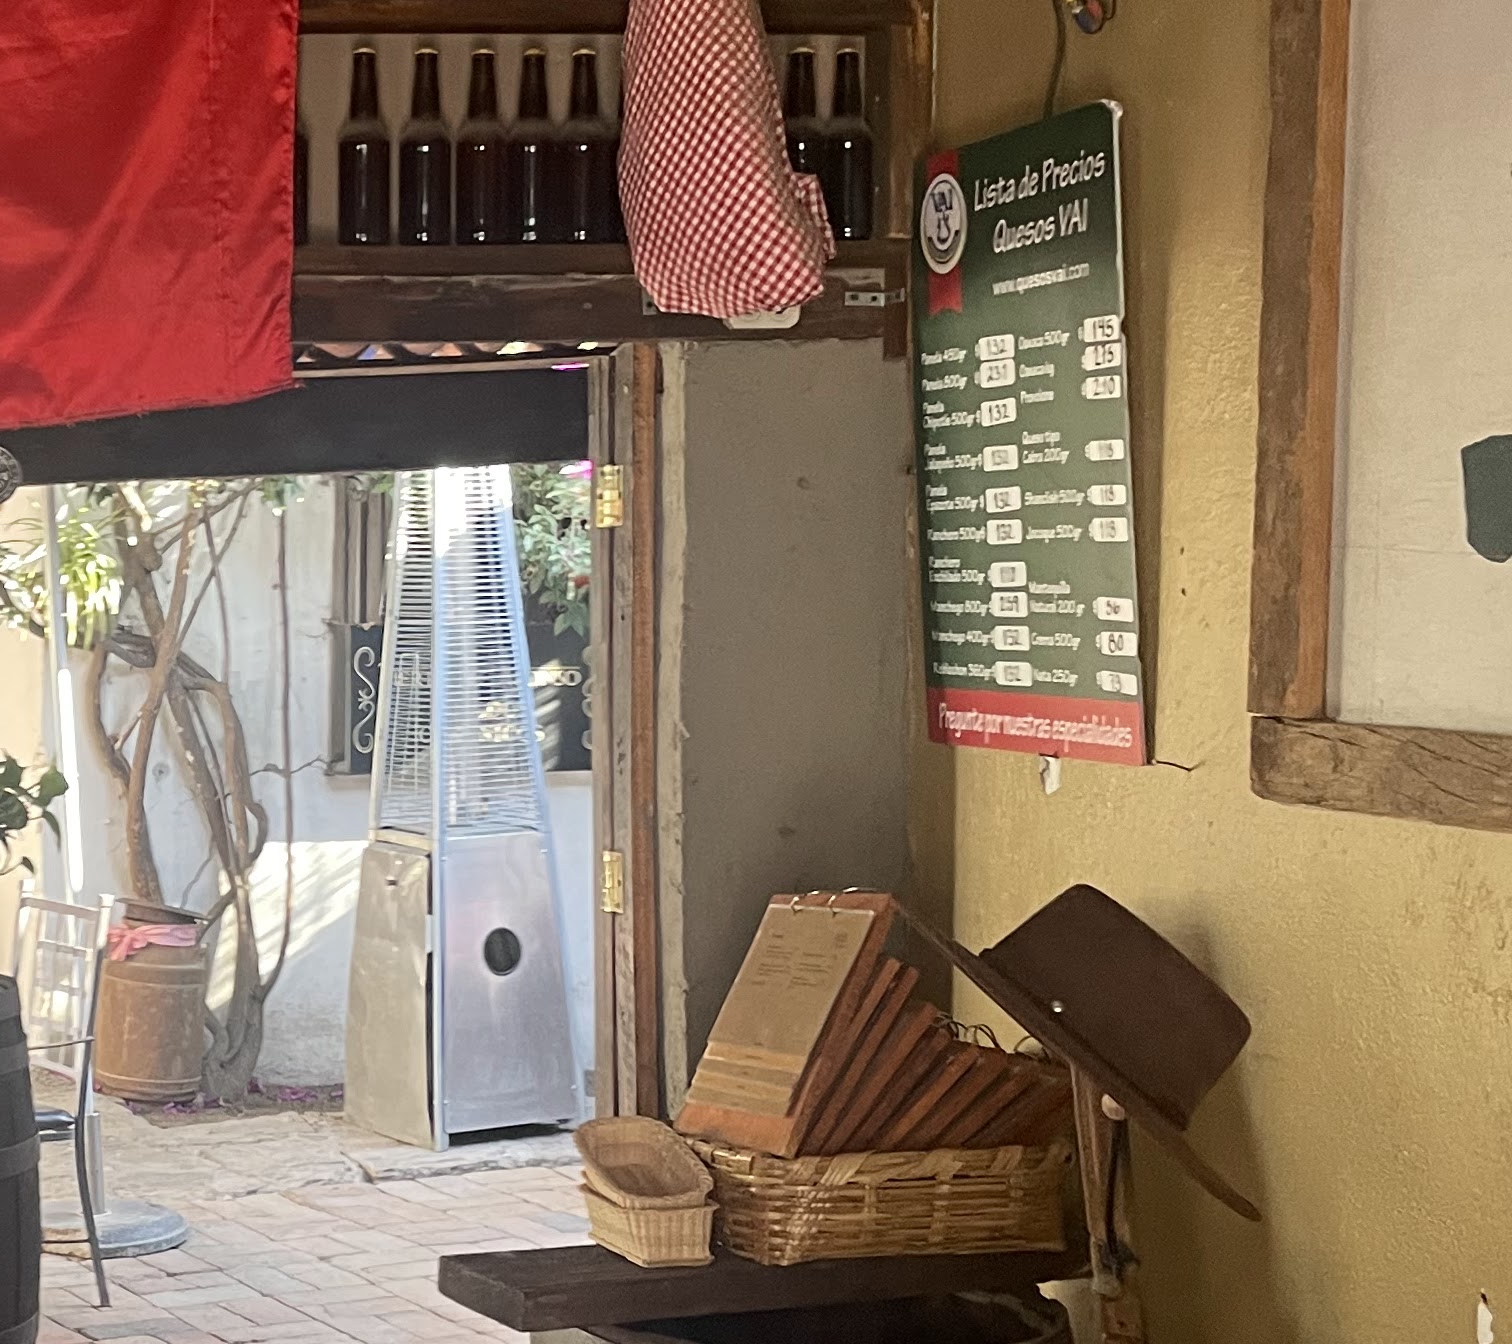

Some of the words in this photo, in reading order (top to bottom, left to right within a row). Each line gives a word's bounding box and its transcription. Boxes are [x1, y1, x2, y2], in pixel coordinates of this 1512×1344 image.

[975, 177, 1015, 211] Lista
[1018, 164, 1038, 200] de
[1041, 149, 1105, 193] Precios
[993, 216, 1056, 254] Quesos
[1059, 198, 1089, 237] VAI
[1093, 318, 1114, 340] 145
[989, 403, 1010, 423] 132
